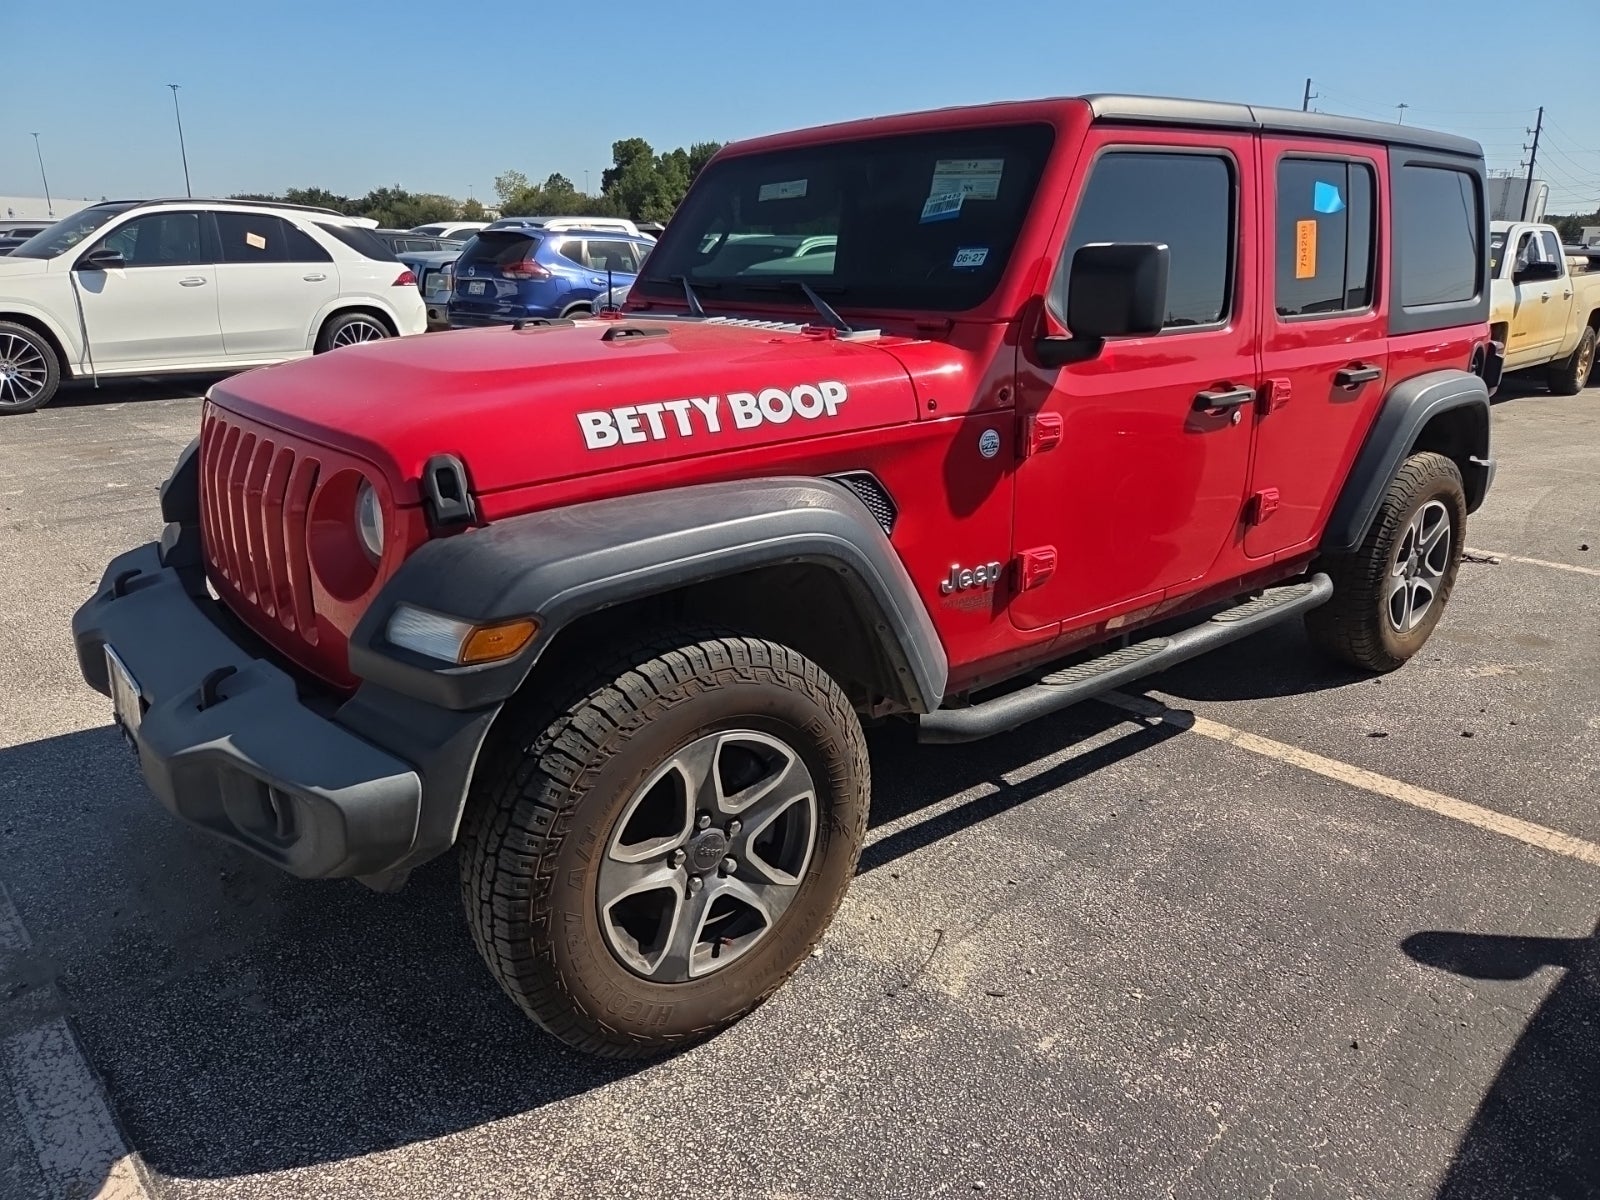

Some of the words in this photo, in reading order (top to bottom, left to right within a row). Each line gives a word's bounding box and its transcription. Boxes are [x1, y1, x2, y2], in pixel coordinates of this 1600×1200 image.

[576, 395, 721, 450] BETTY
[726, 380, 848, 430] BOOP
[941, 561, 1000, 593] Jeep
